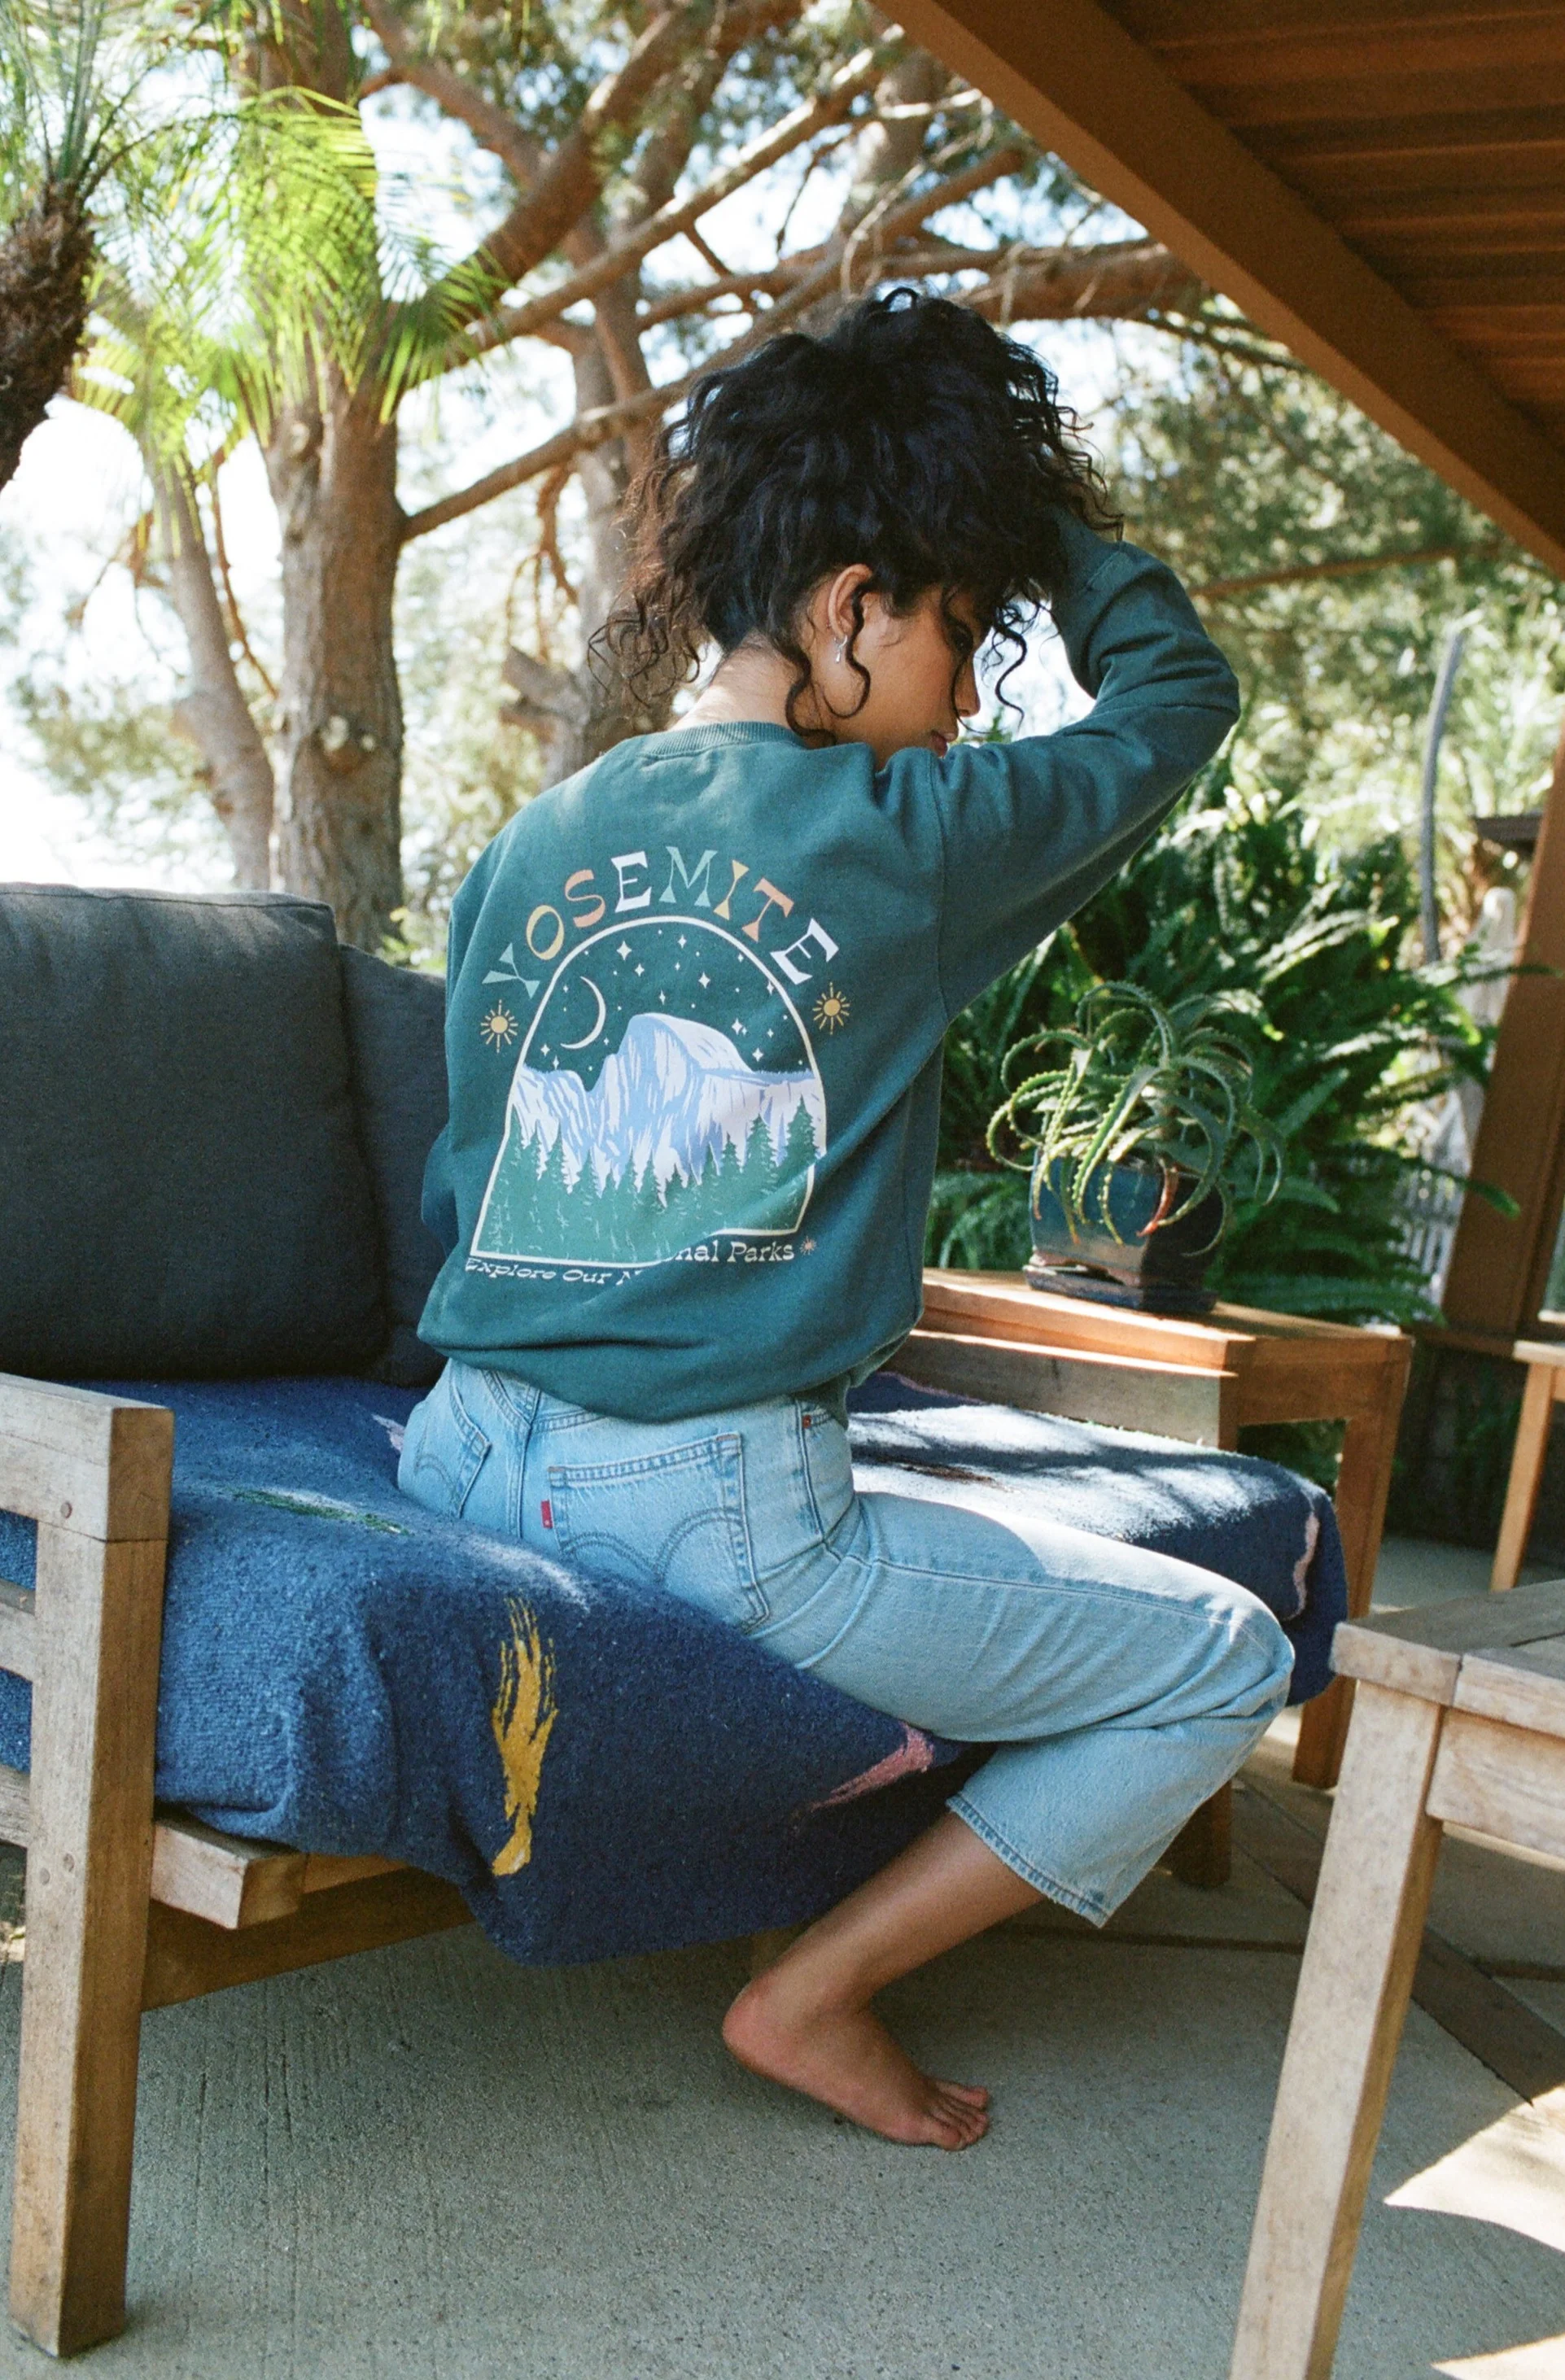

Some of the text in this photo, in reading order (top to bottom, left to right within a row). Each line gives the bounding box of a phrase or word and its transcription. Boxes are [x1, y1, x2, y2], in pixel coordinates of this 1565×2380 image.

[481, 845, 840, 999] YOSEMITE
[465, 1257, 557, 1279] Explore
[562, 1269, 613, 1285] Our
[727, 1241, 795, 1263] Parks
